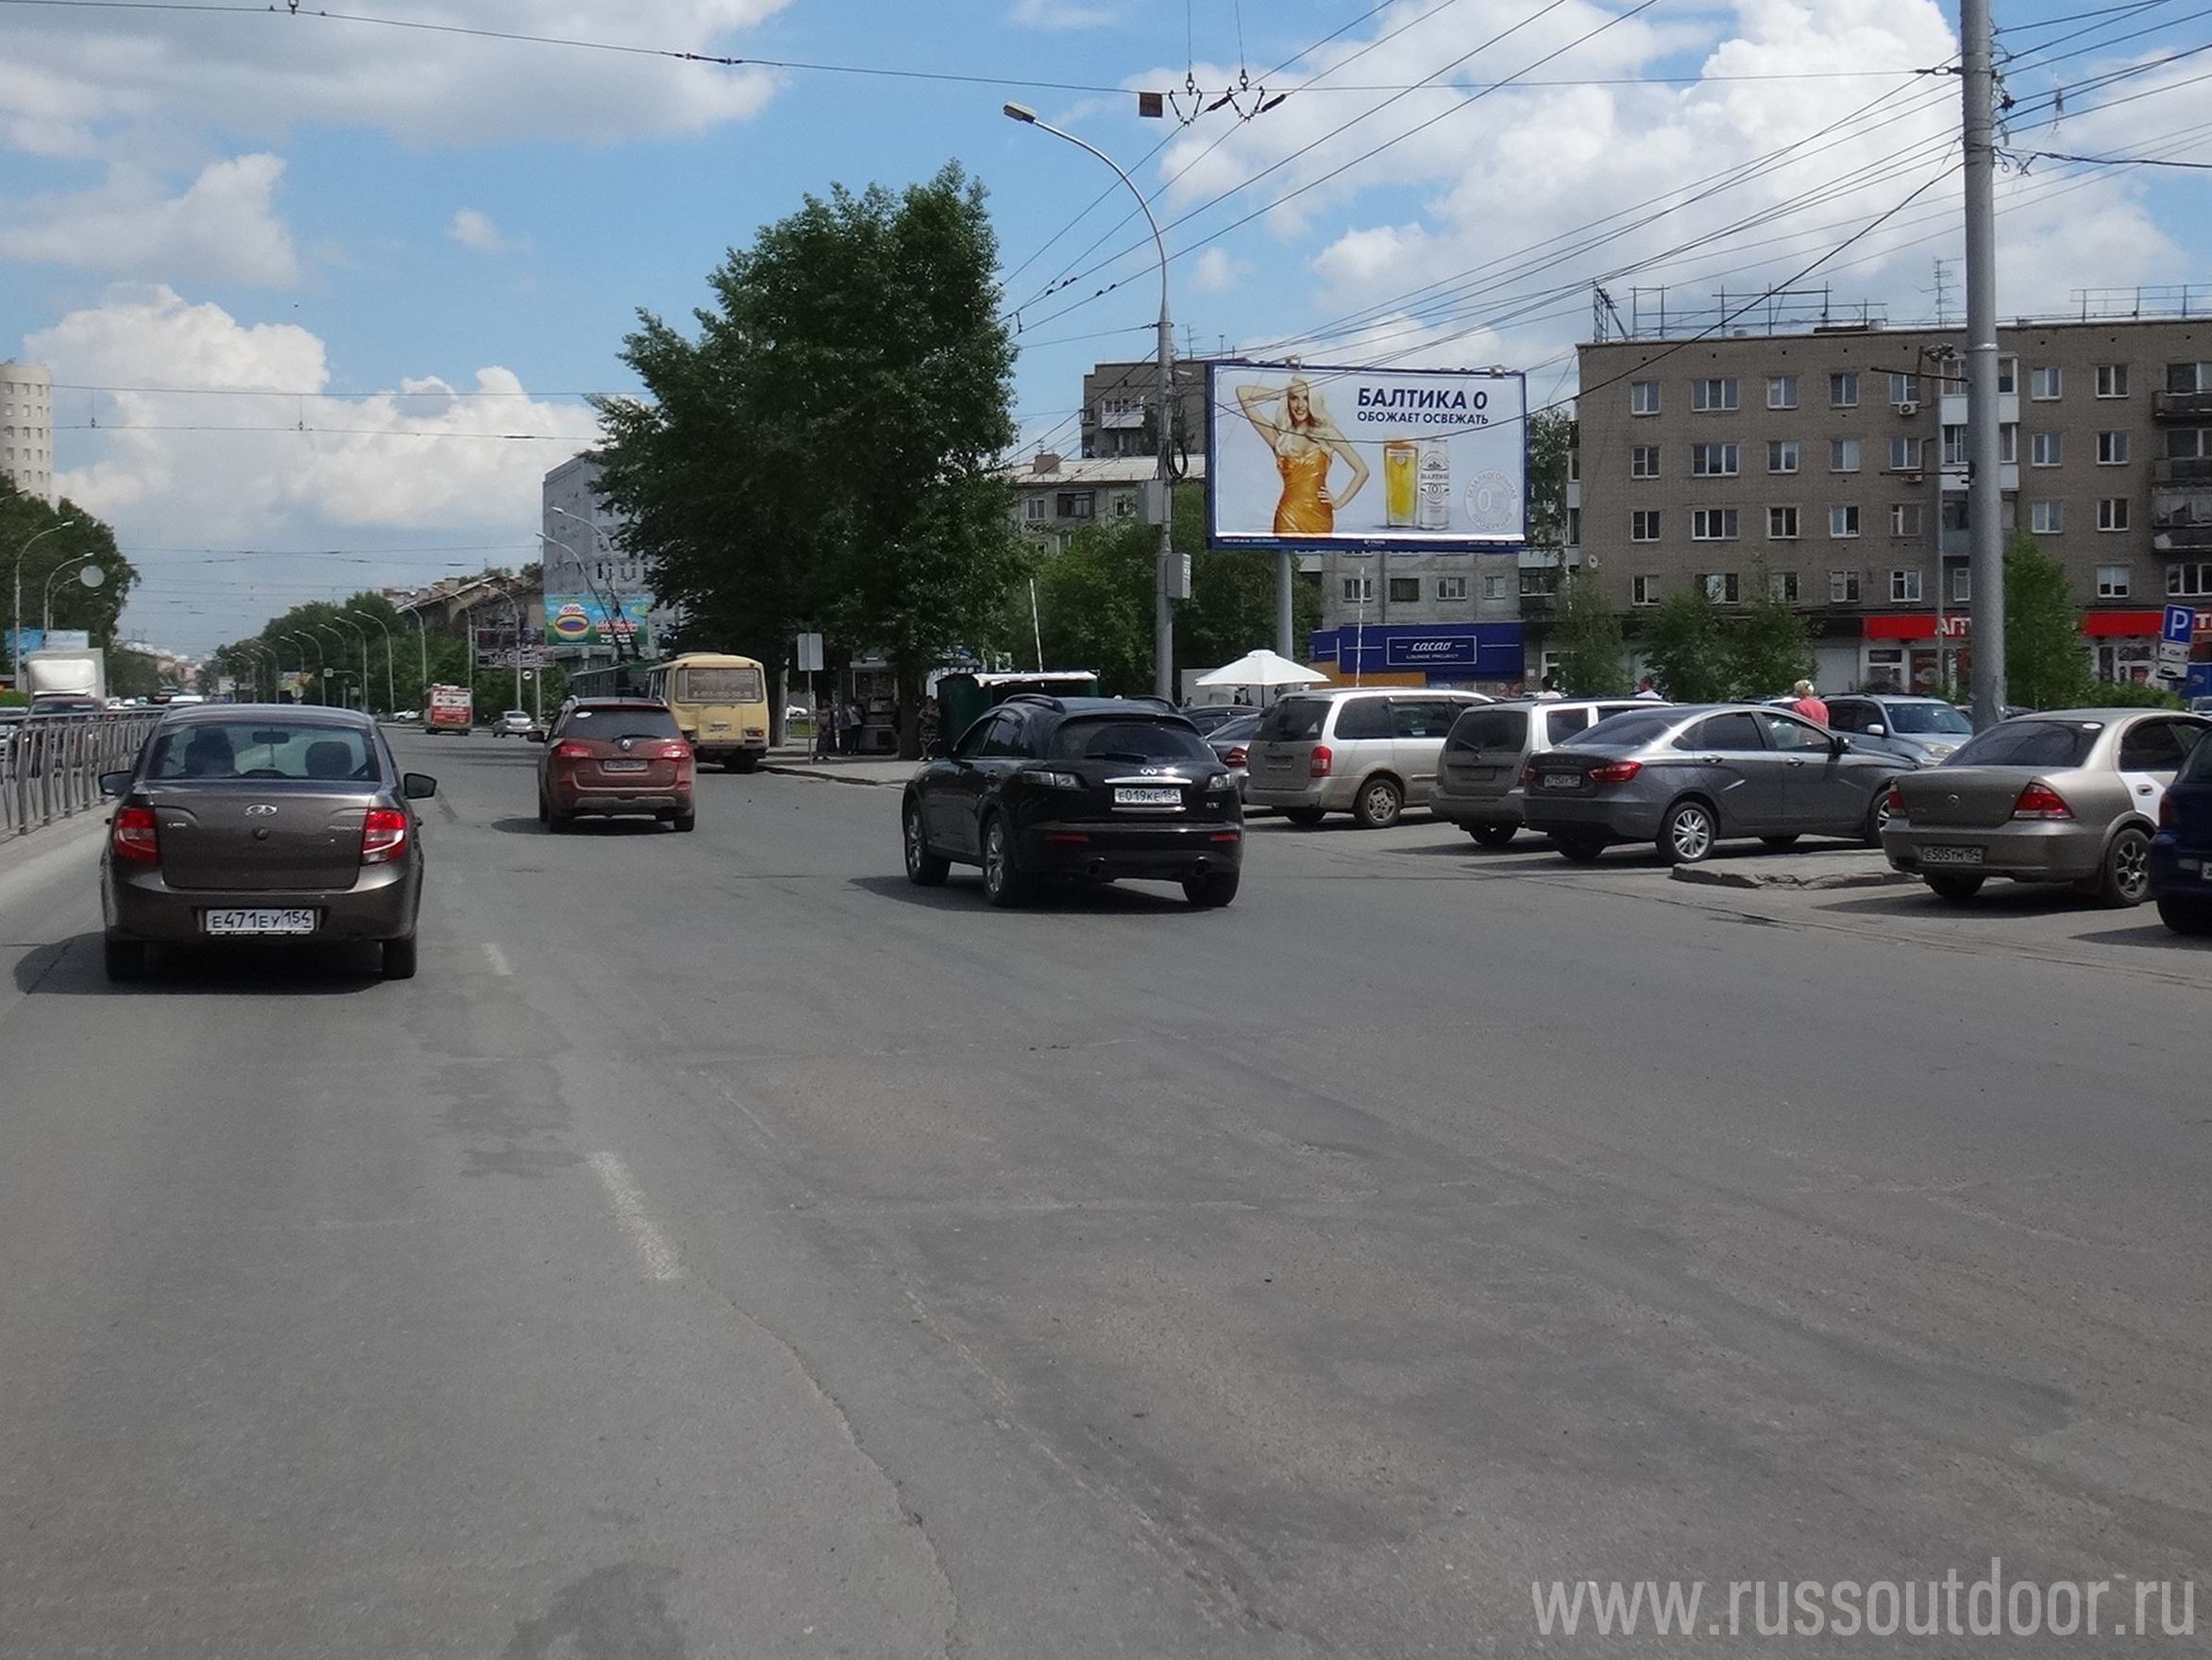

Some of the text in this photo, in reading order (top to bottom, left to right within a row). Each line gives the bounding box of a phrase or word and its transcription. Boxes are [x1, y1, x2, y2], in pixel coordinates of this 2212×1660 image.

[1358, 388, 1488, 410] БАЛТИКА 0
[1357, 411, 1489, 425] ОБОЖАЕТ ОСВЕЖАТЬ
[2170, 610, 2189, 637] P
[1411, 641, 1454, 652] cacao
